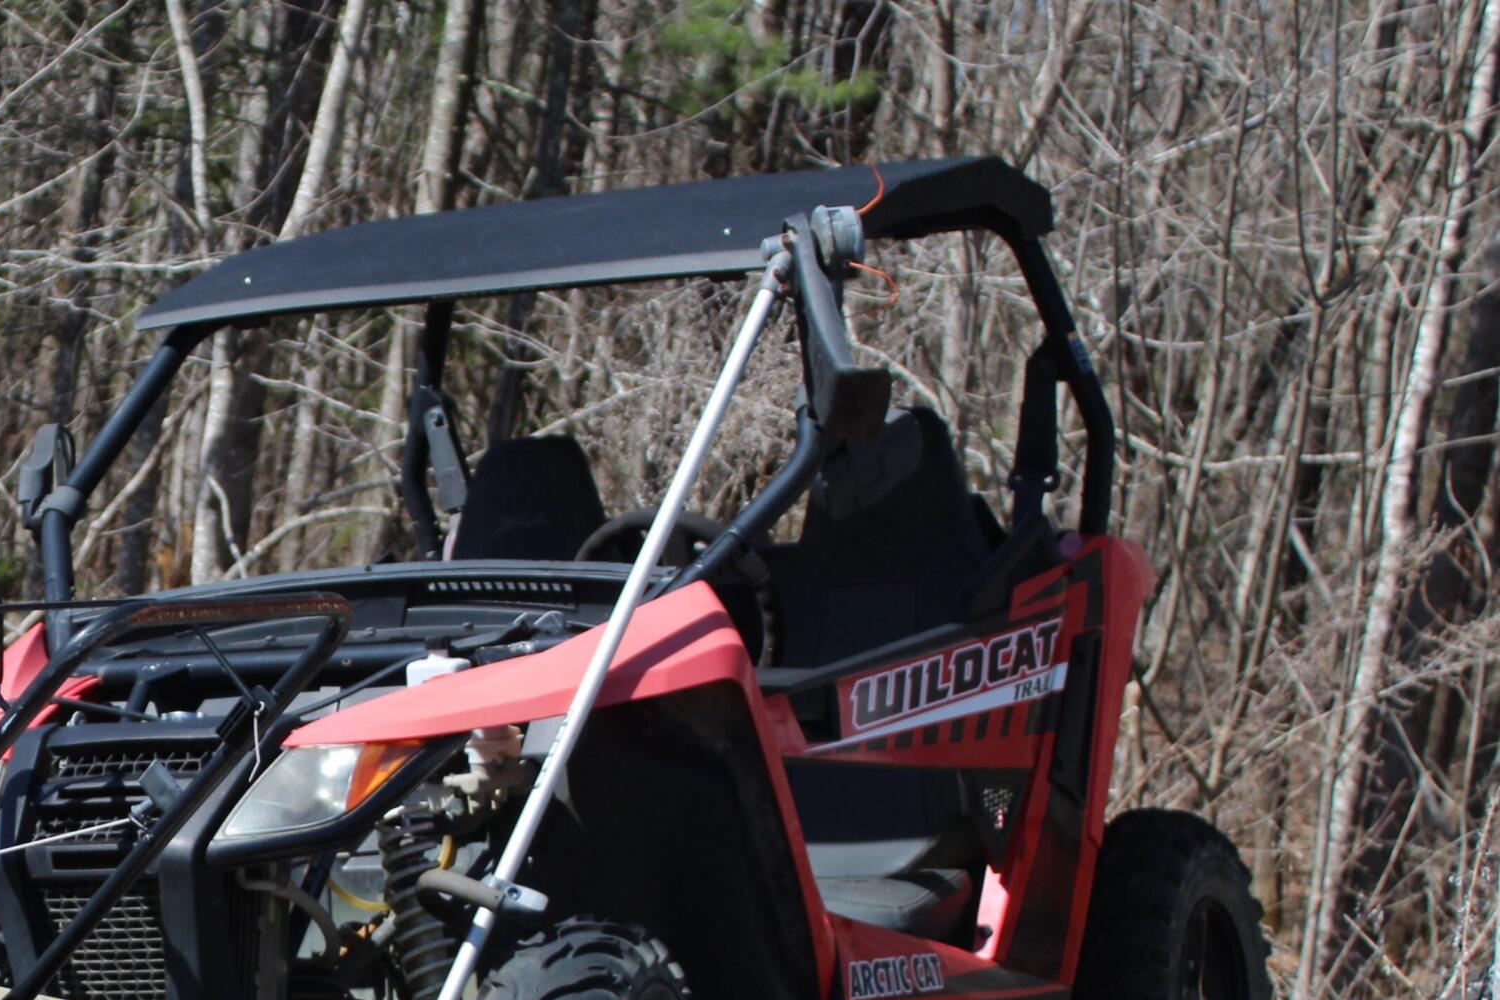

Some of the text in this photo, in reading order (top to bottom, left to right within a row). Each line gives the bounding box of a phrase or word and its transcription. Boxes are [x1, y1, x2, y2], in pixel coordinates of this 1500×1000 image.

[850, 617, 1062, 730] WILDCAT
[849, 953, 944, 1000] ARCTIC CAT
